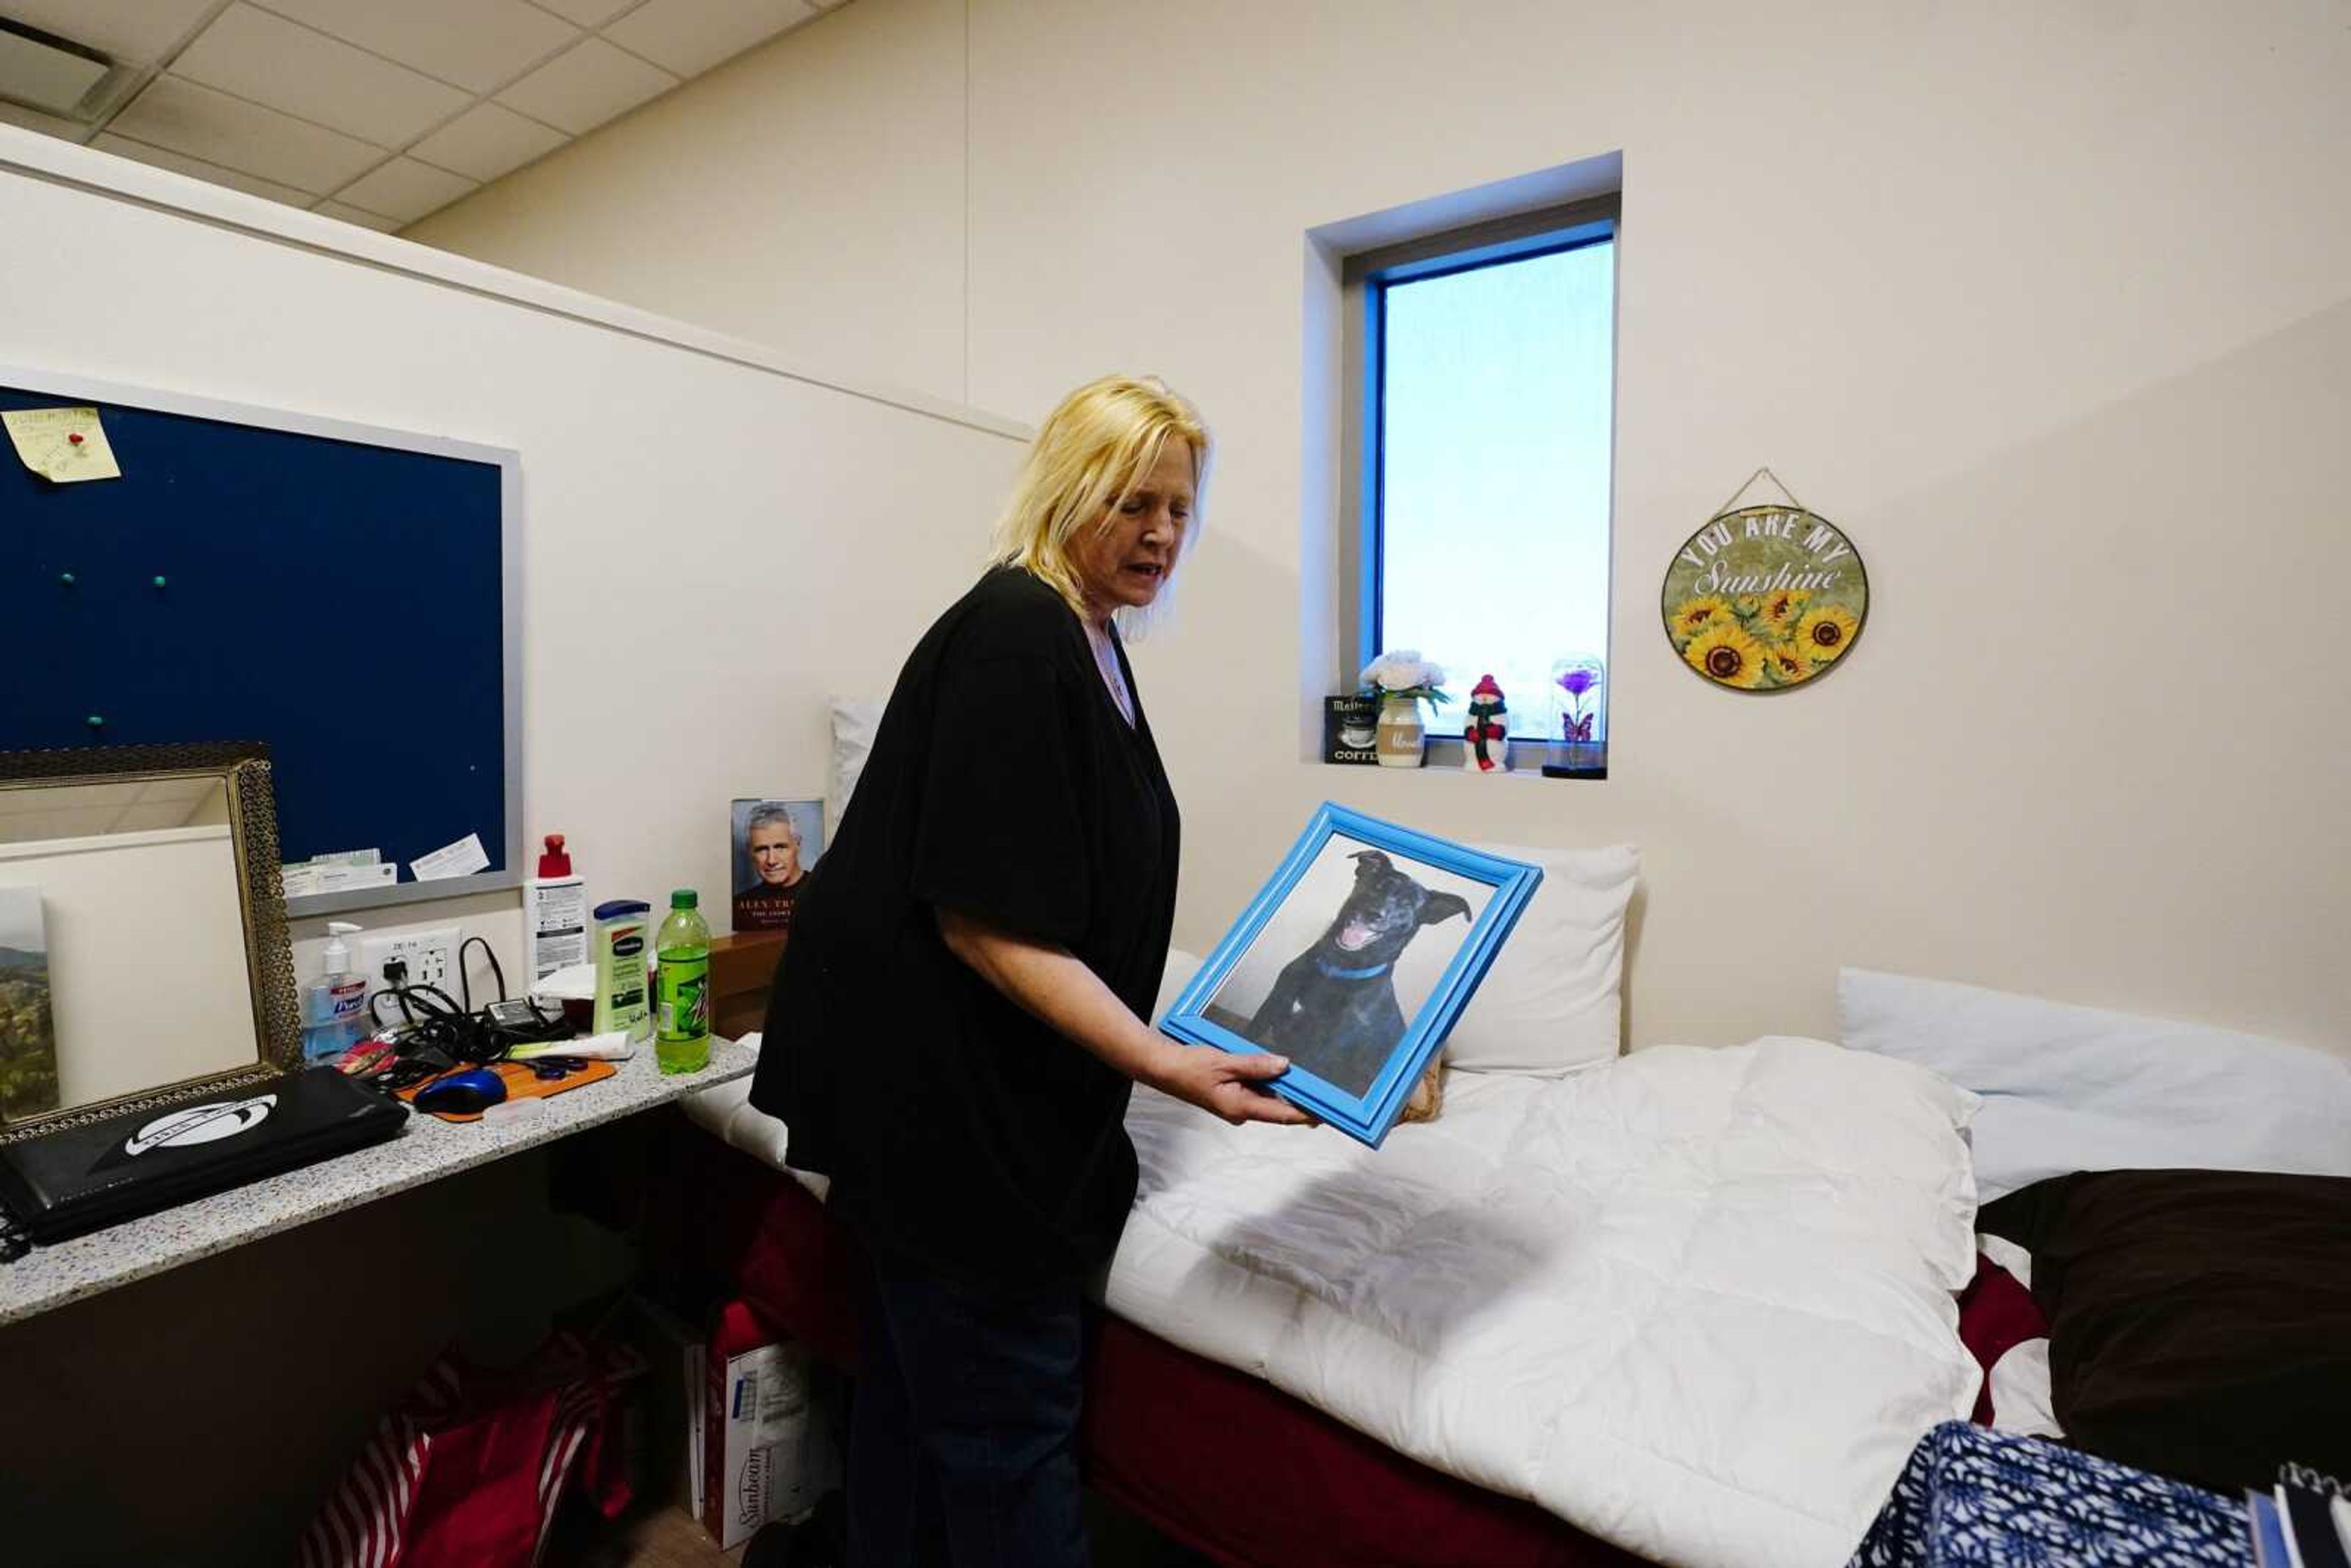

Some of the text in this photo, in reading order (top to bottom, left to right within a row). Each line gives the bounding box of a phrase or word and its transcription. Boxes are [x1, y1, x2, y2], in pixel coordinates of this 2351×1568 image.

[1681, 513, 1850, 568] YOU ARE MY
[1694, 560, 1842, 596] Sunshine
[739, 1447, 762, 1529] Sunbeam
